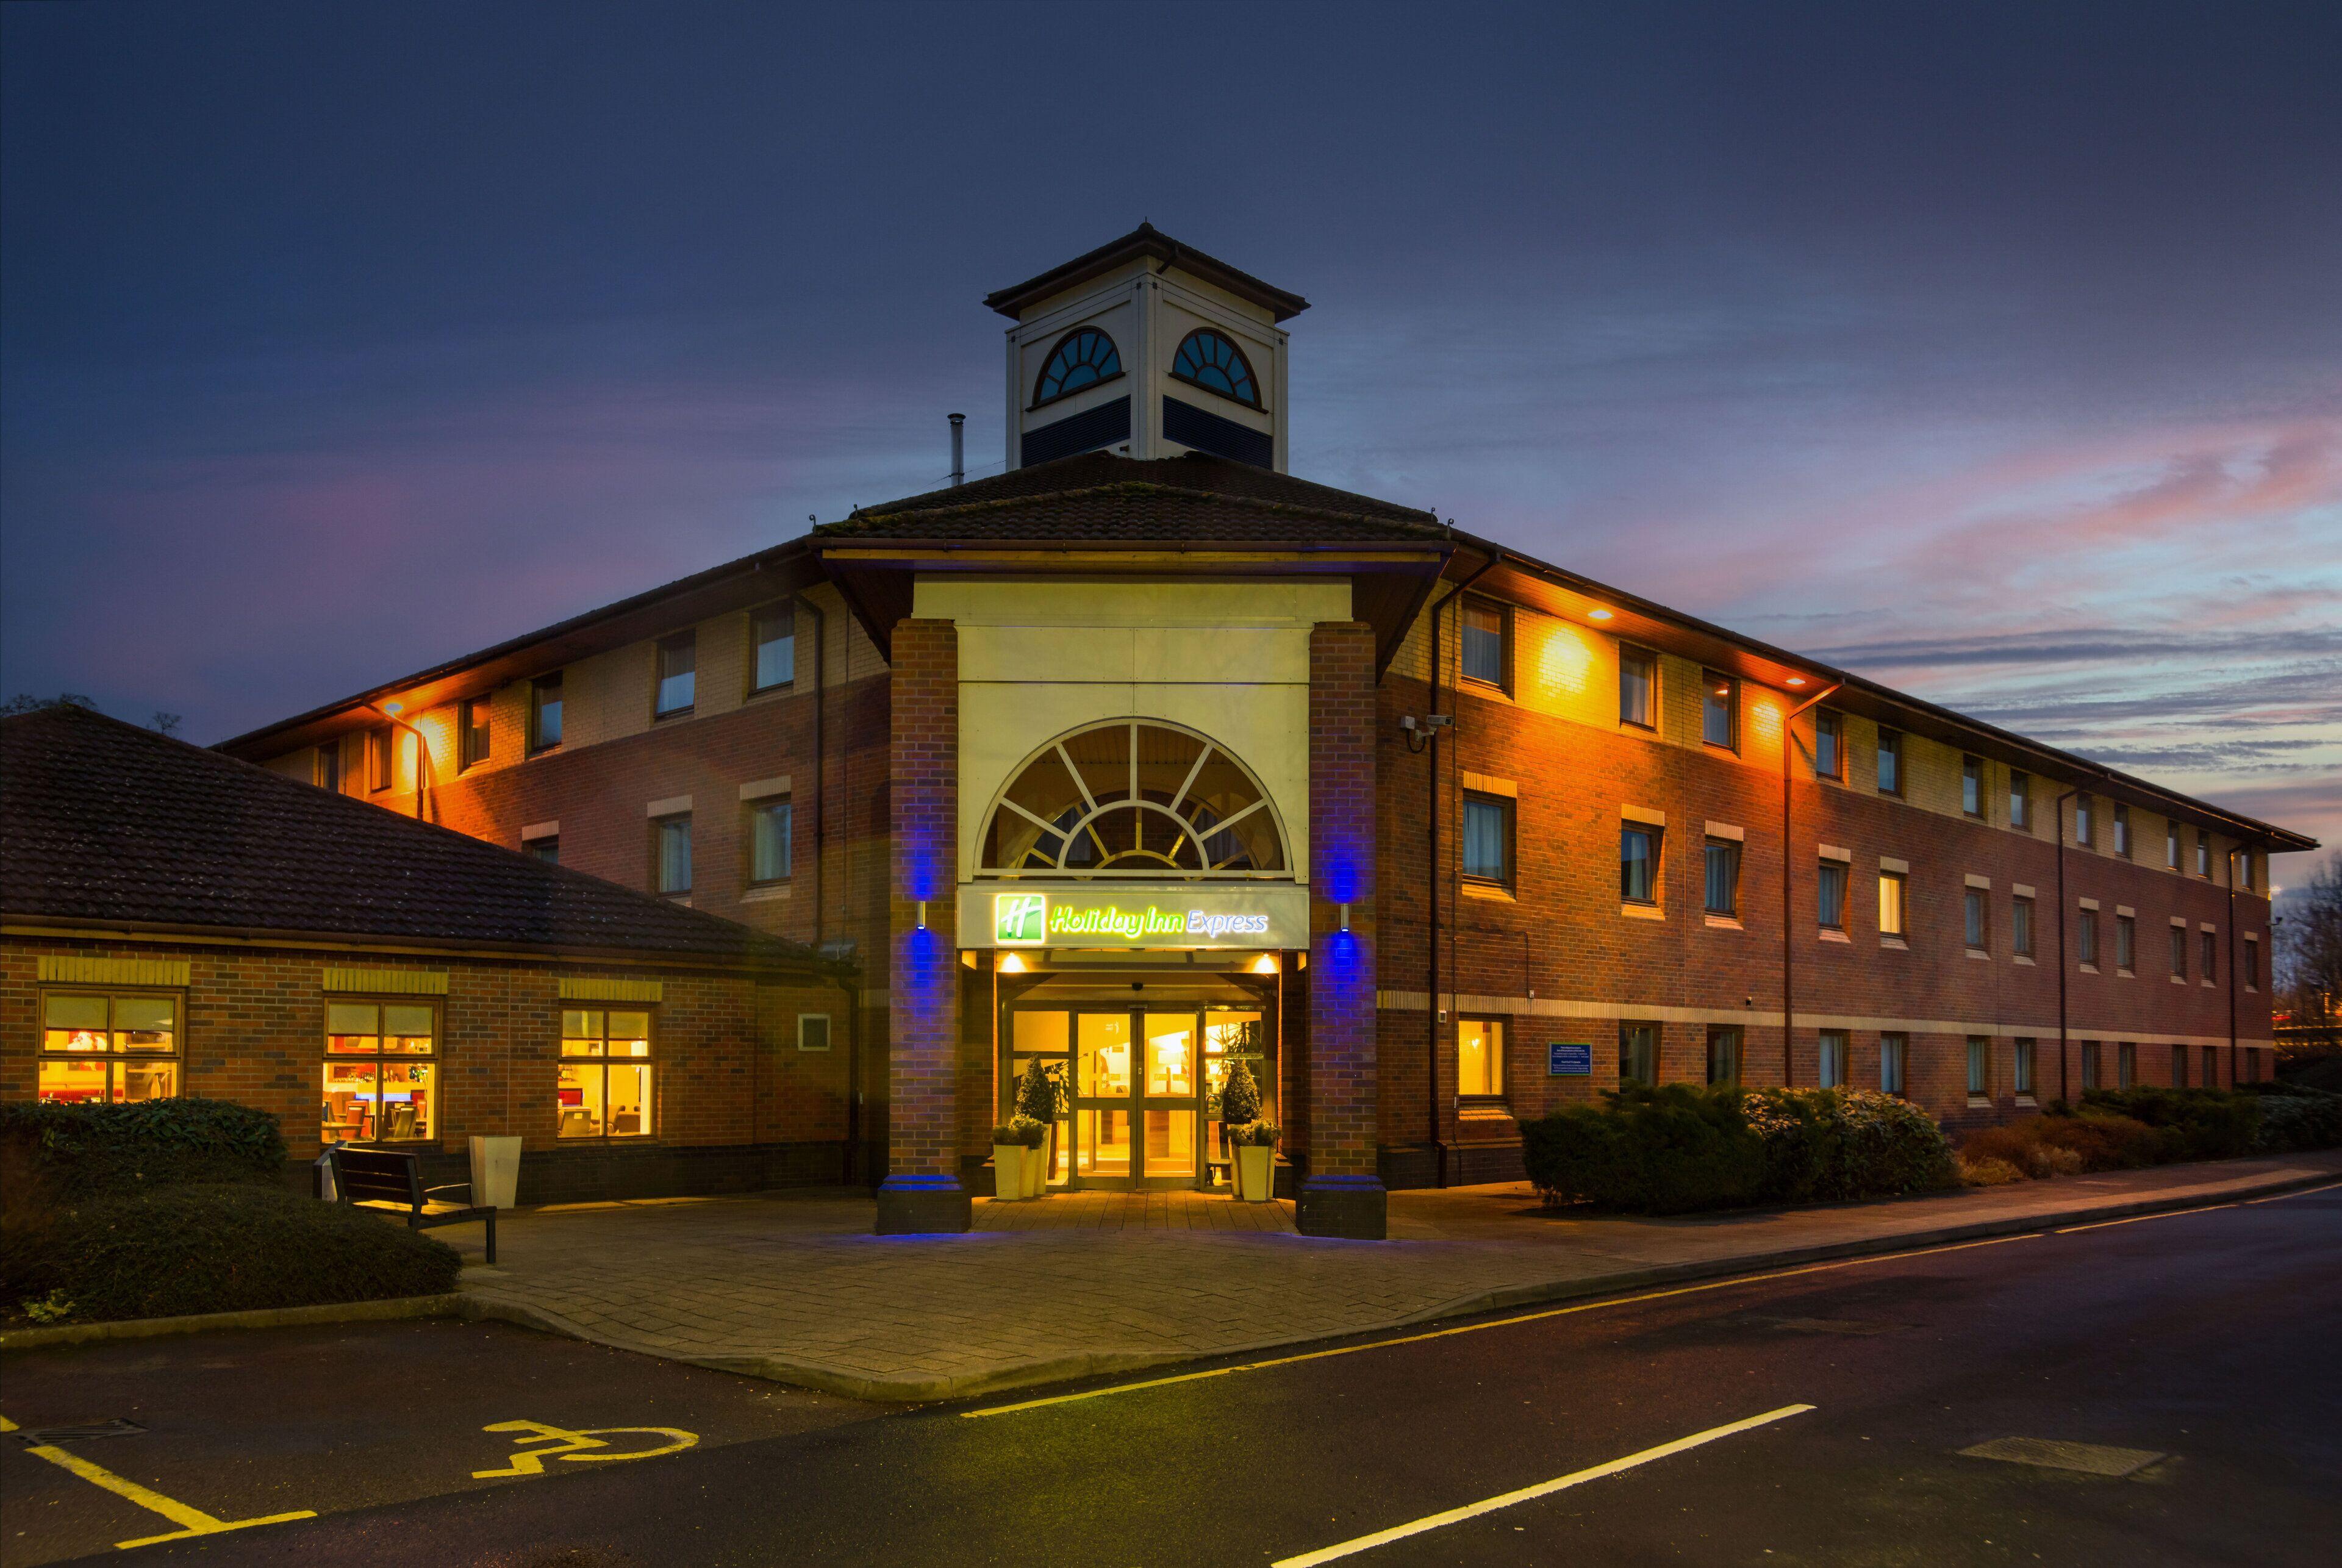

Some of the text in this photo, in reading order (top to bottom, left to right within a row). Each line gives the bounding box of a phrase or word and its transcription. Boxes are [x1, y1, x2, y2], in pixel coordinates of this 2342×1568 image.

[1050, 906, 1268, 938] Holiday Inn Express
